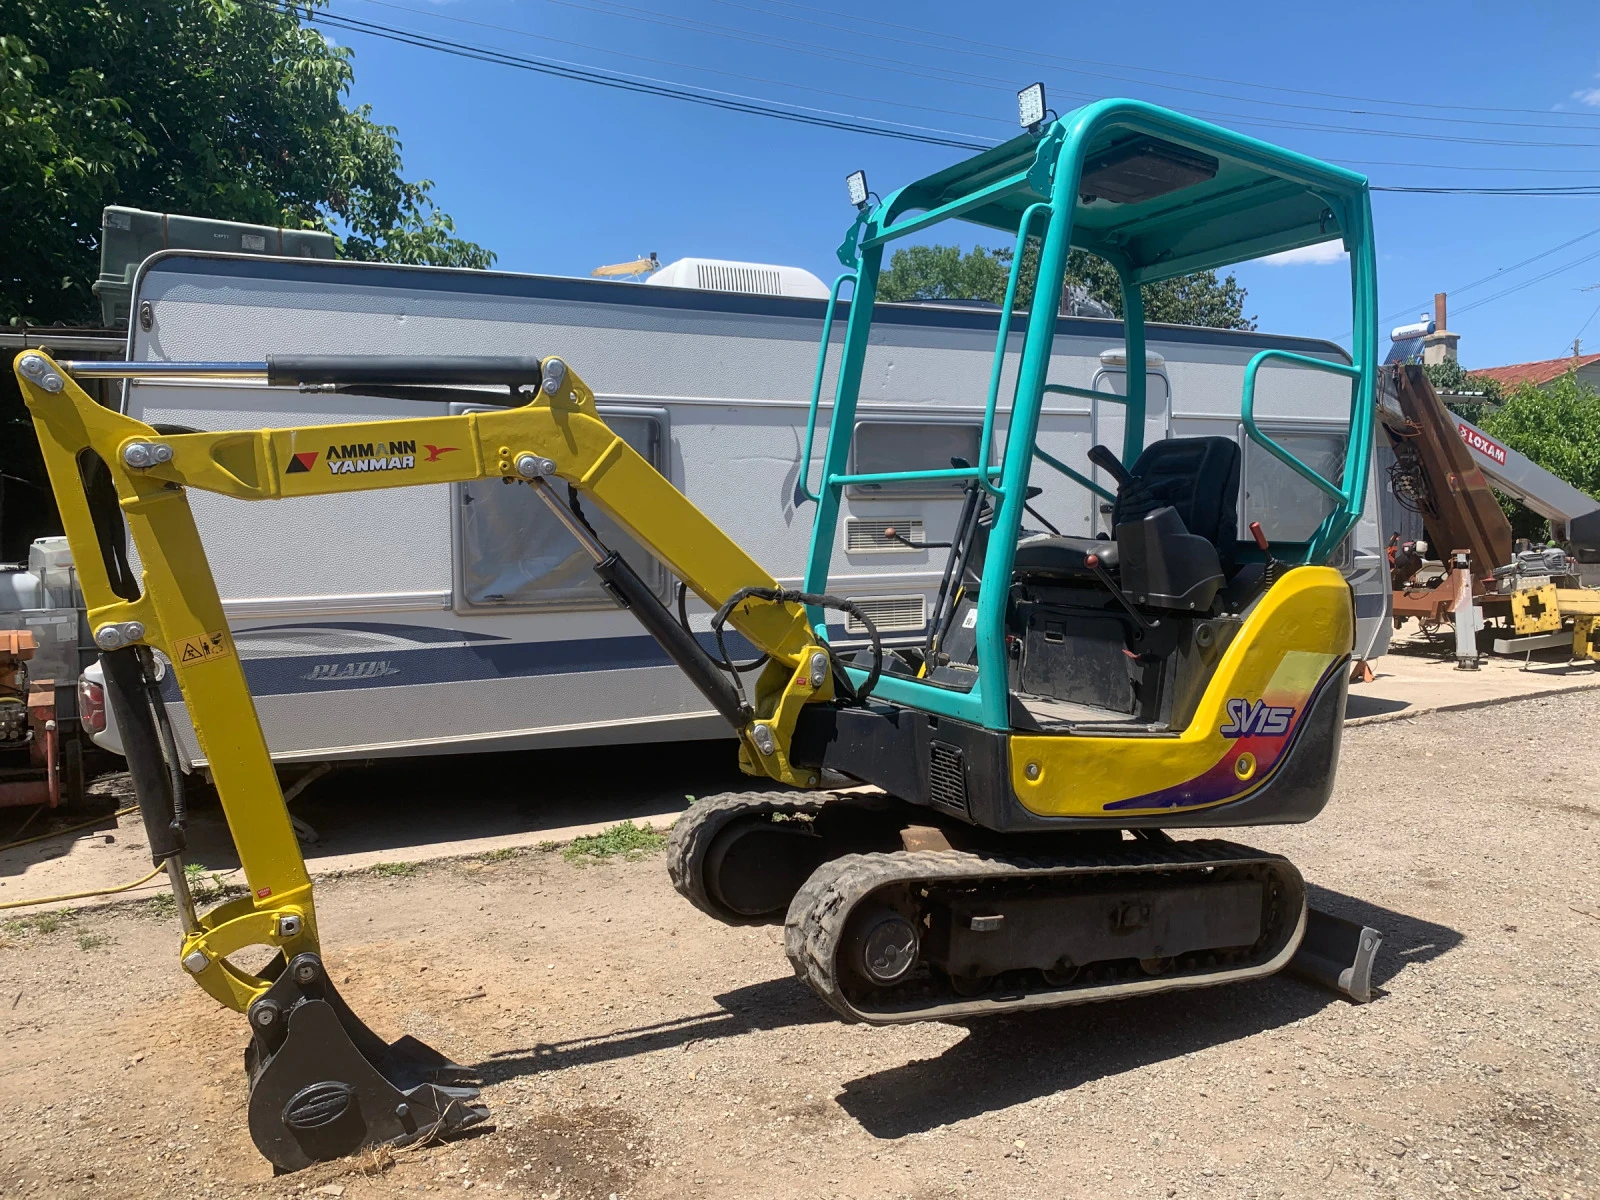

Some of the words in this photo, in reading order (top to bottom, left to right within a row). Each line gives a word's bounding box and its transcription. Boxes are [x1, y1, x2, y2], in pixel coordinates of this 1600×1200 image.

[326, 440, 416, 459] AMMANN
[1468, 431, 1505, 463] LOXAM
[328, 456, 415, 475] YANMAR
[310, 660, 391, 679] PLATIN
[1220, 699, 1295, 737] SV15
